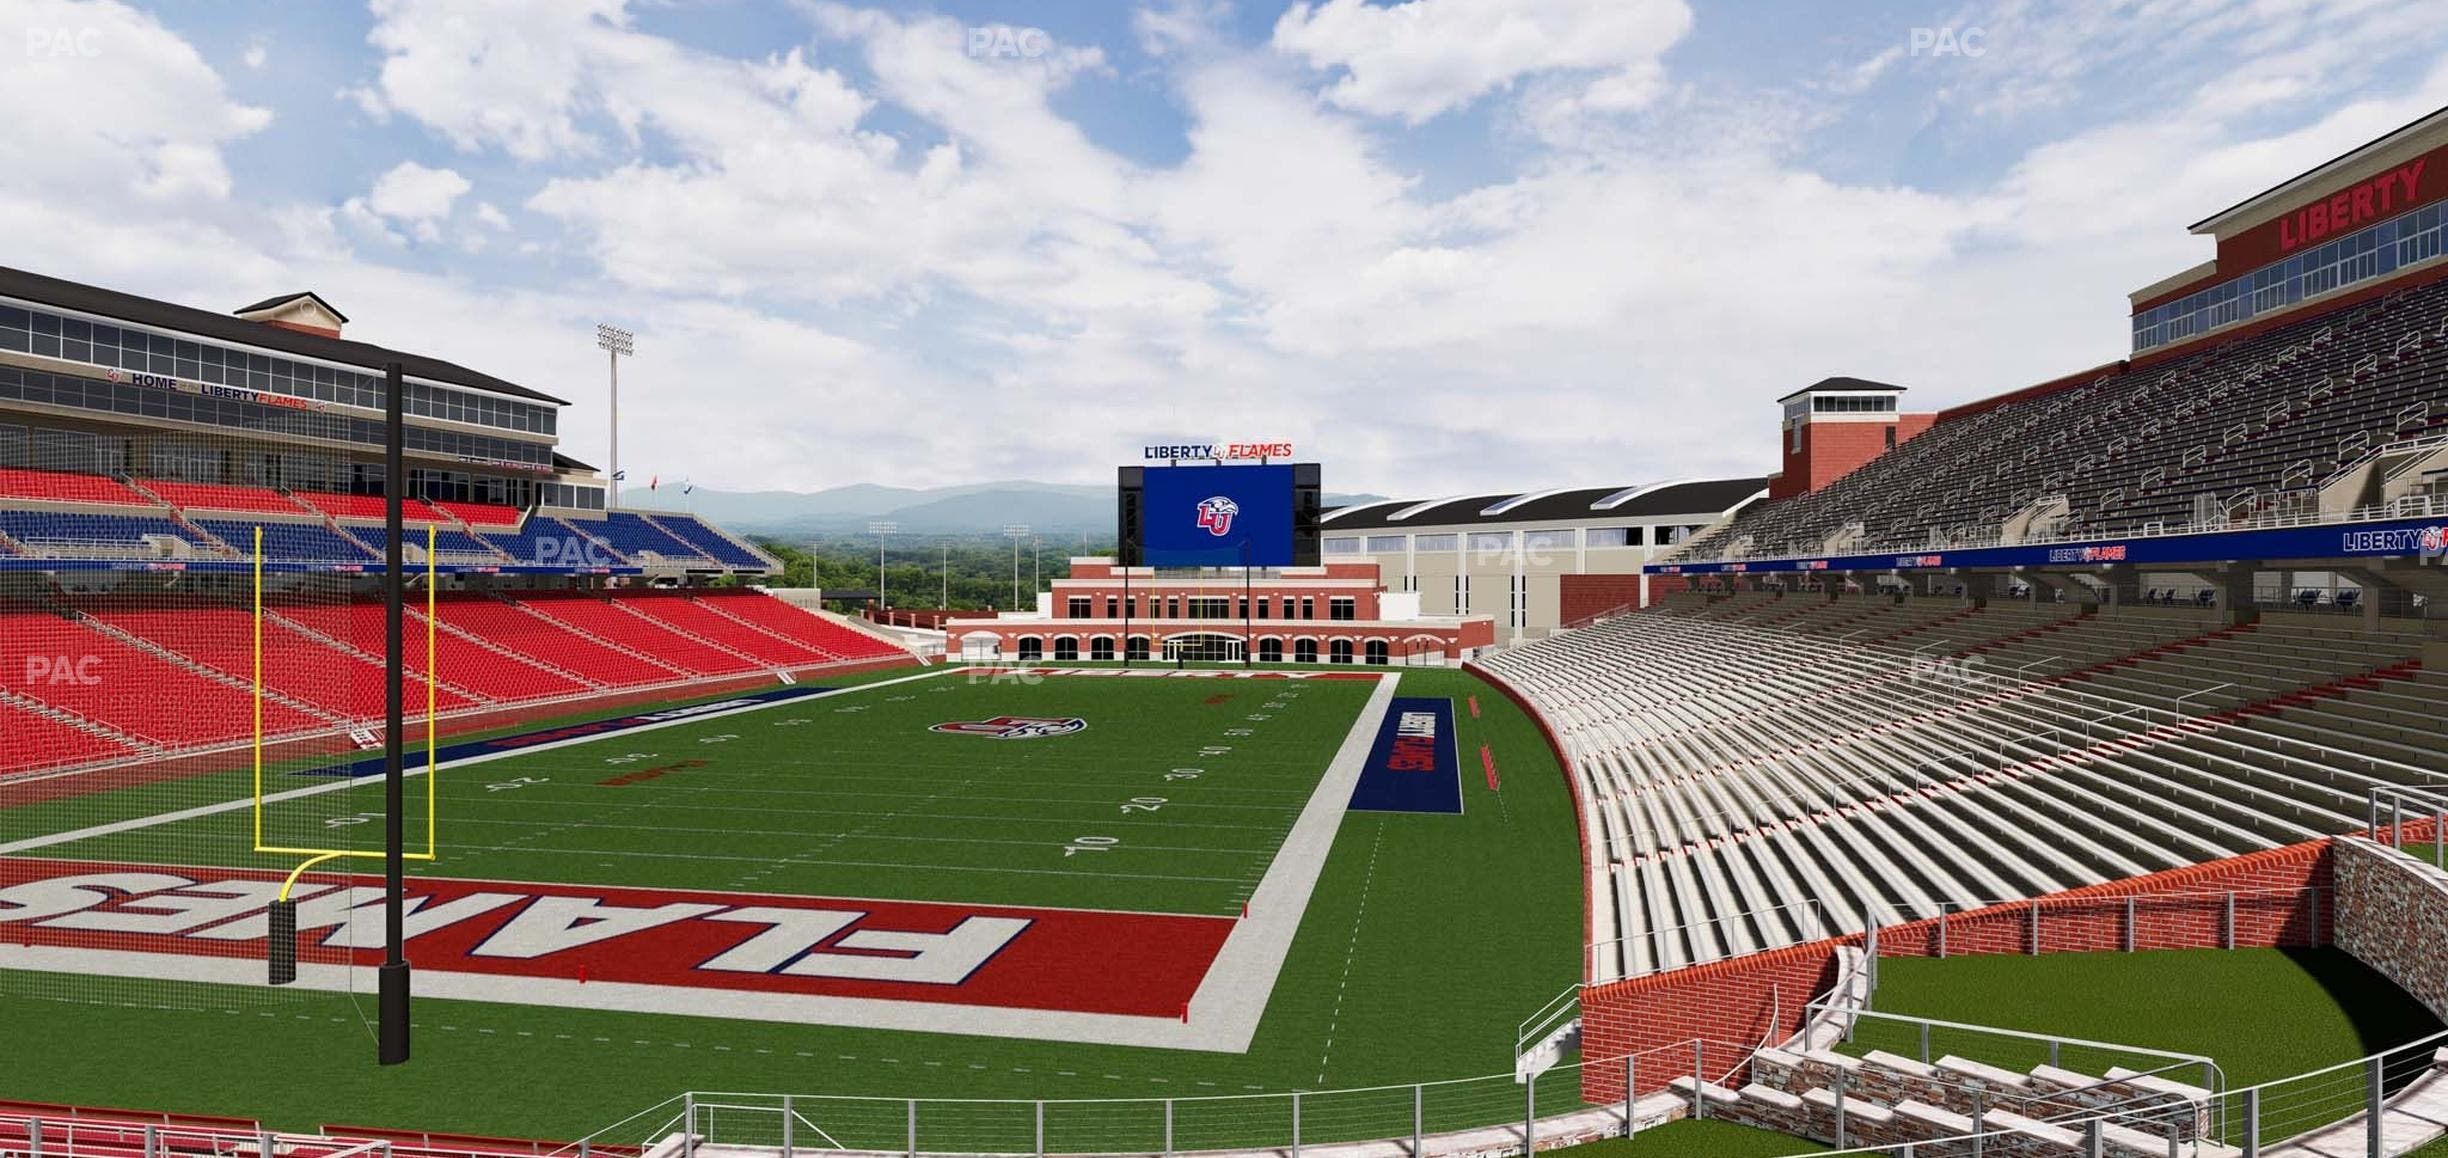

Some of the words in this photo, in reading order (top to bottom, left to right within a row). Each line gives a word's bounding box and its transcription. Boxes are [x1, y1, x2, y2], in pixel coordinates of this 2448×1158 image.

[2280, 159, 2425, 251] LIBERTY
[132, 373, 177, 391] HOME
[1144, 445, 1212, 459] LIBERTY
[1228, 443, 1292, 457] FLAMES
[2343, 528, 2422, 552] LIBERTY
[1120, 797, 1169, 814] 20
[1064, 836, 1119, 857] 10
